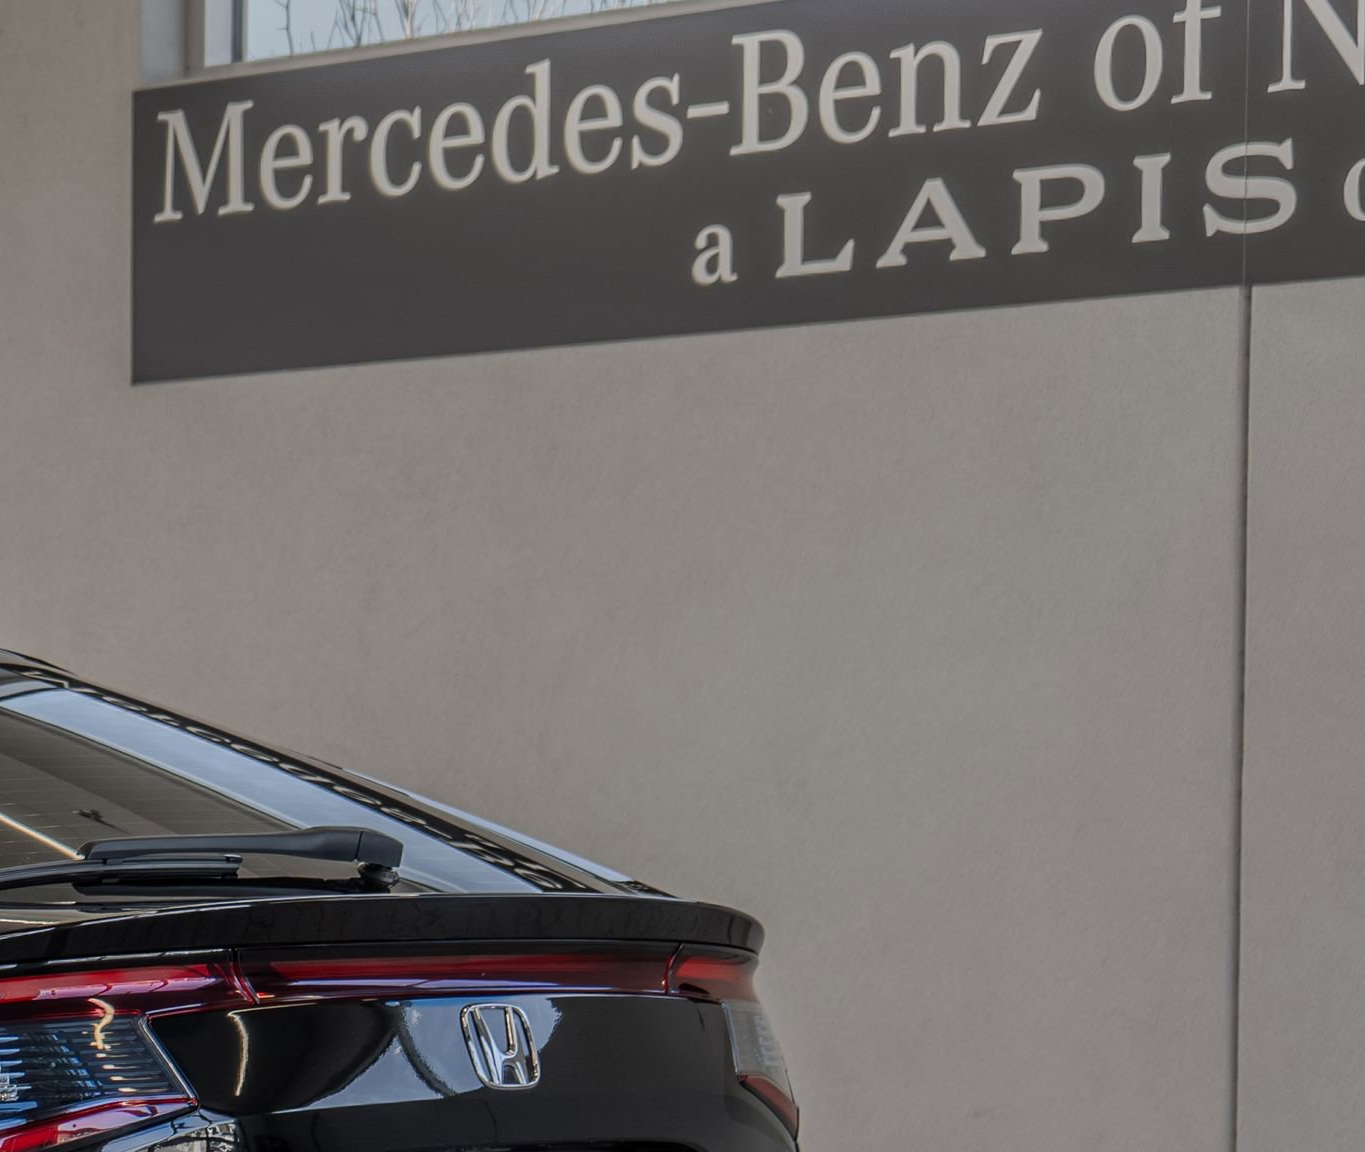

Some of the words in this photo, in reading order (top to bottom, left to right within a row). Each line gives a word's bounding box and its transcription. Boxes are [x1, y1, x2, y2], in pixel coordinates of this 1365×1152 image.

[153, 28, 1044, 225] Mercedes-Benz
[1093, 0, 1222, 112] of
[691, 223, 738, 285] a
[775, 137, 1298, 279] LAPIS
